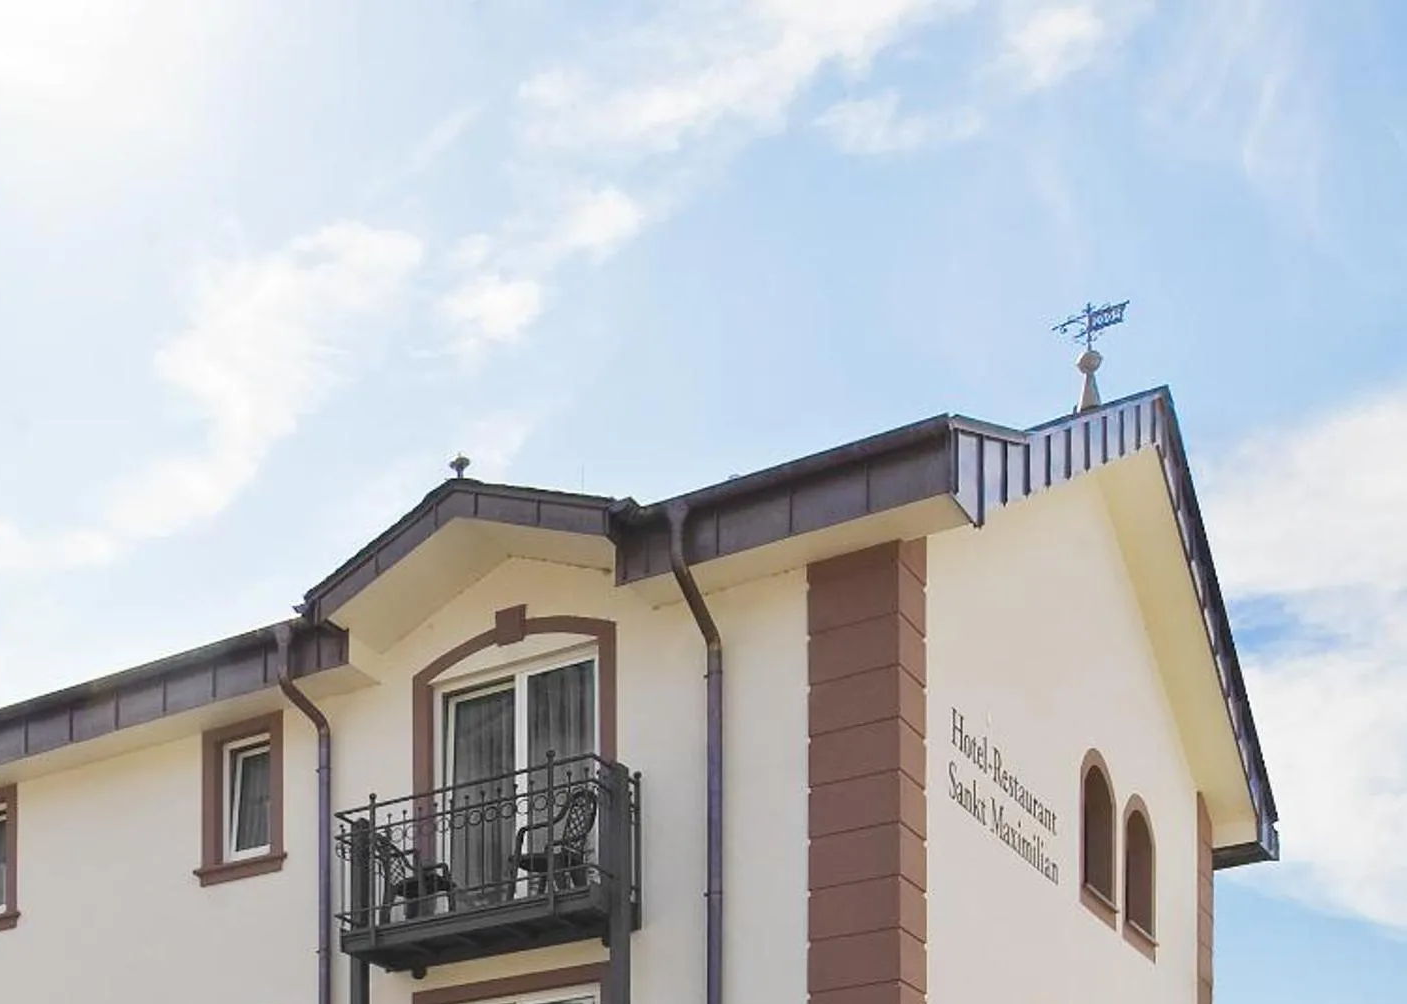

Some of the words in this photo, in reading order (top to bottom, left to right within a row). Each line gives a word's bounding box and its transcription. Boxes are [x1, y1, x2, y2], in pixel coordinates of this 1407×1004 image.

[948, 760, 987, 826] Sankt
[989, 796, 1060, 886] Maximilian
[951, 706, 1058, 836] Hotel-Restaurant
